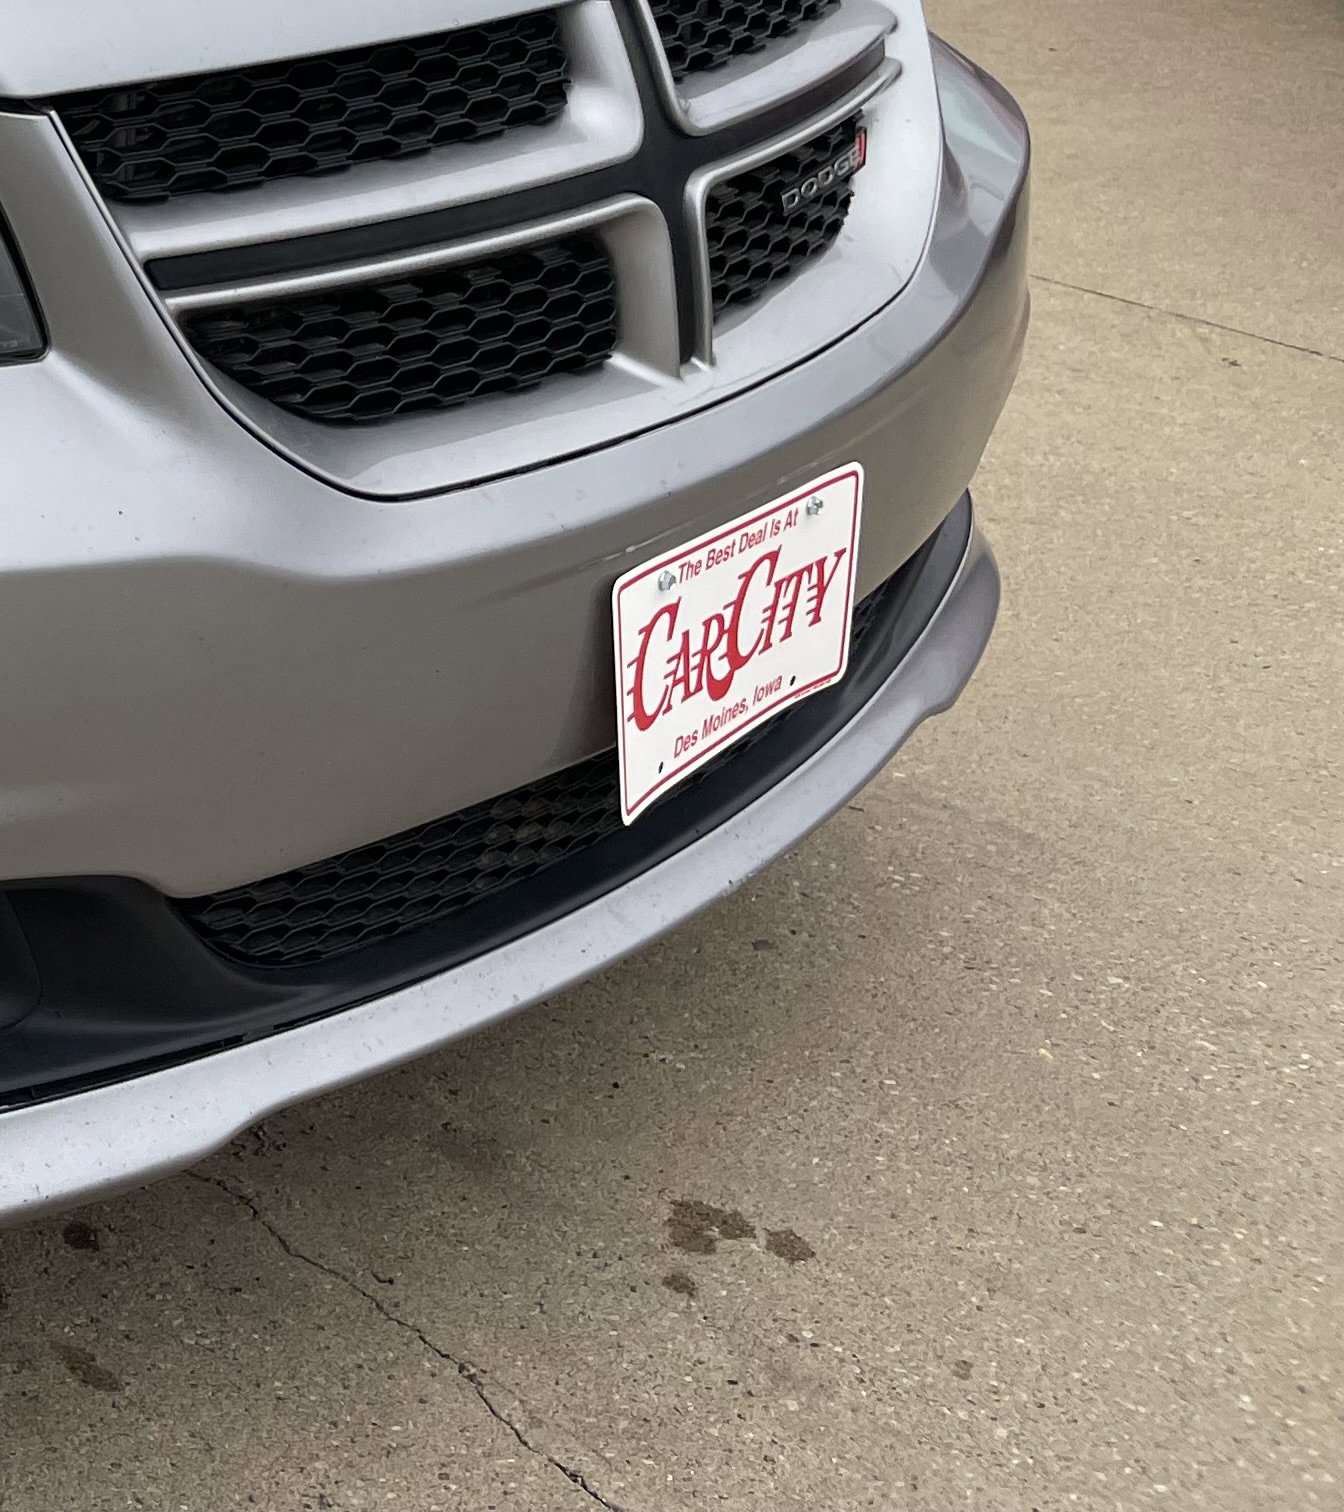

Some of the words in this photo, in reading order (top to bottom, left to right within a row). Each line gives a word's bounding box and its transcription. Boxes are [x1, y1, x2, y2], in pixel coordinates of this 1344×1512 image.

[678, 561, 703, 584] The
[705, 541, 736, 571] Best
[739, 527, 767, 553] Deal
[769, 517, 782, 537] Is
[784, 507, 799, 532] At
[673, 728, 699, 759] Des
[702, 697, 749, 735] Moines,
[752, 673, 783, 707] Iowa
